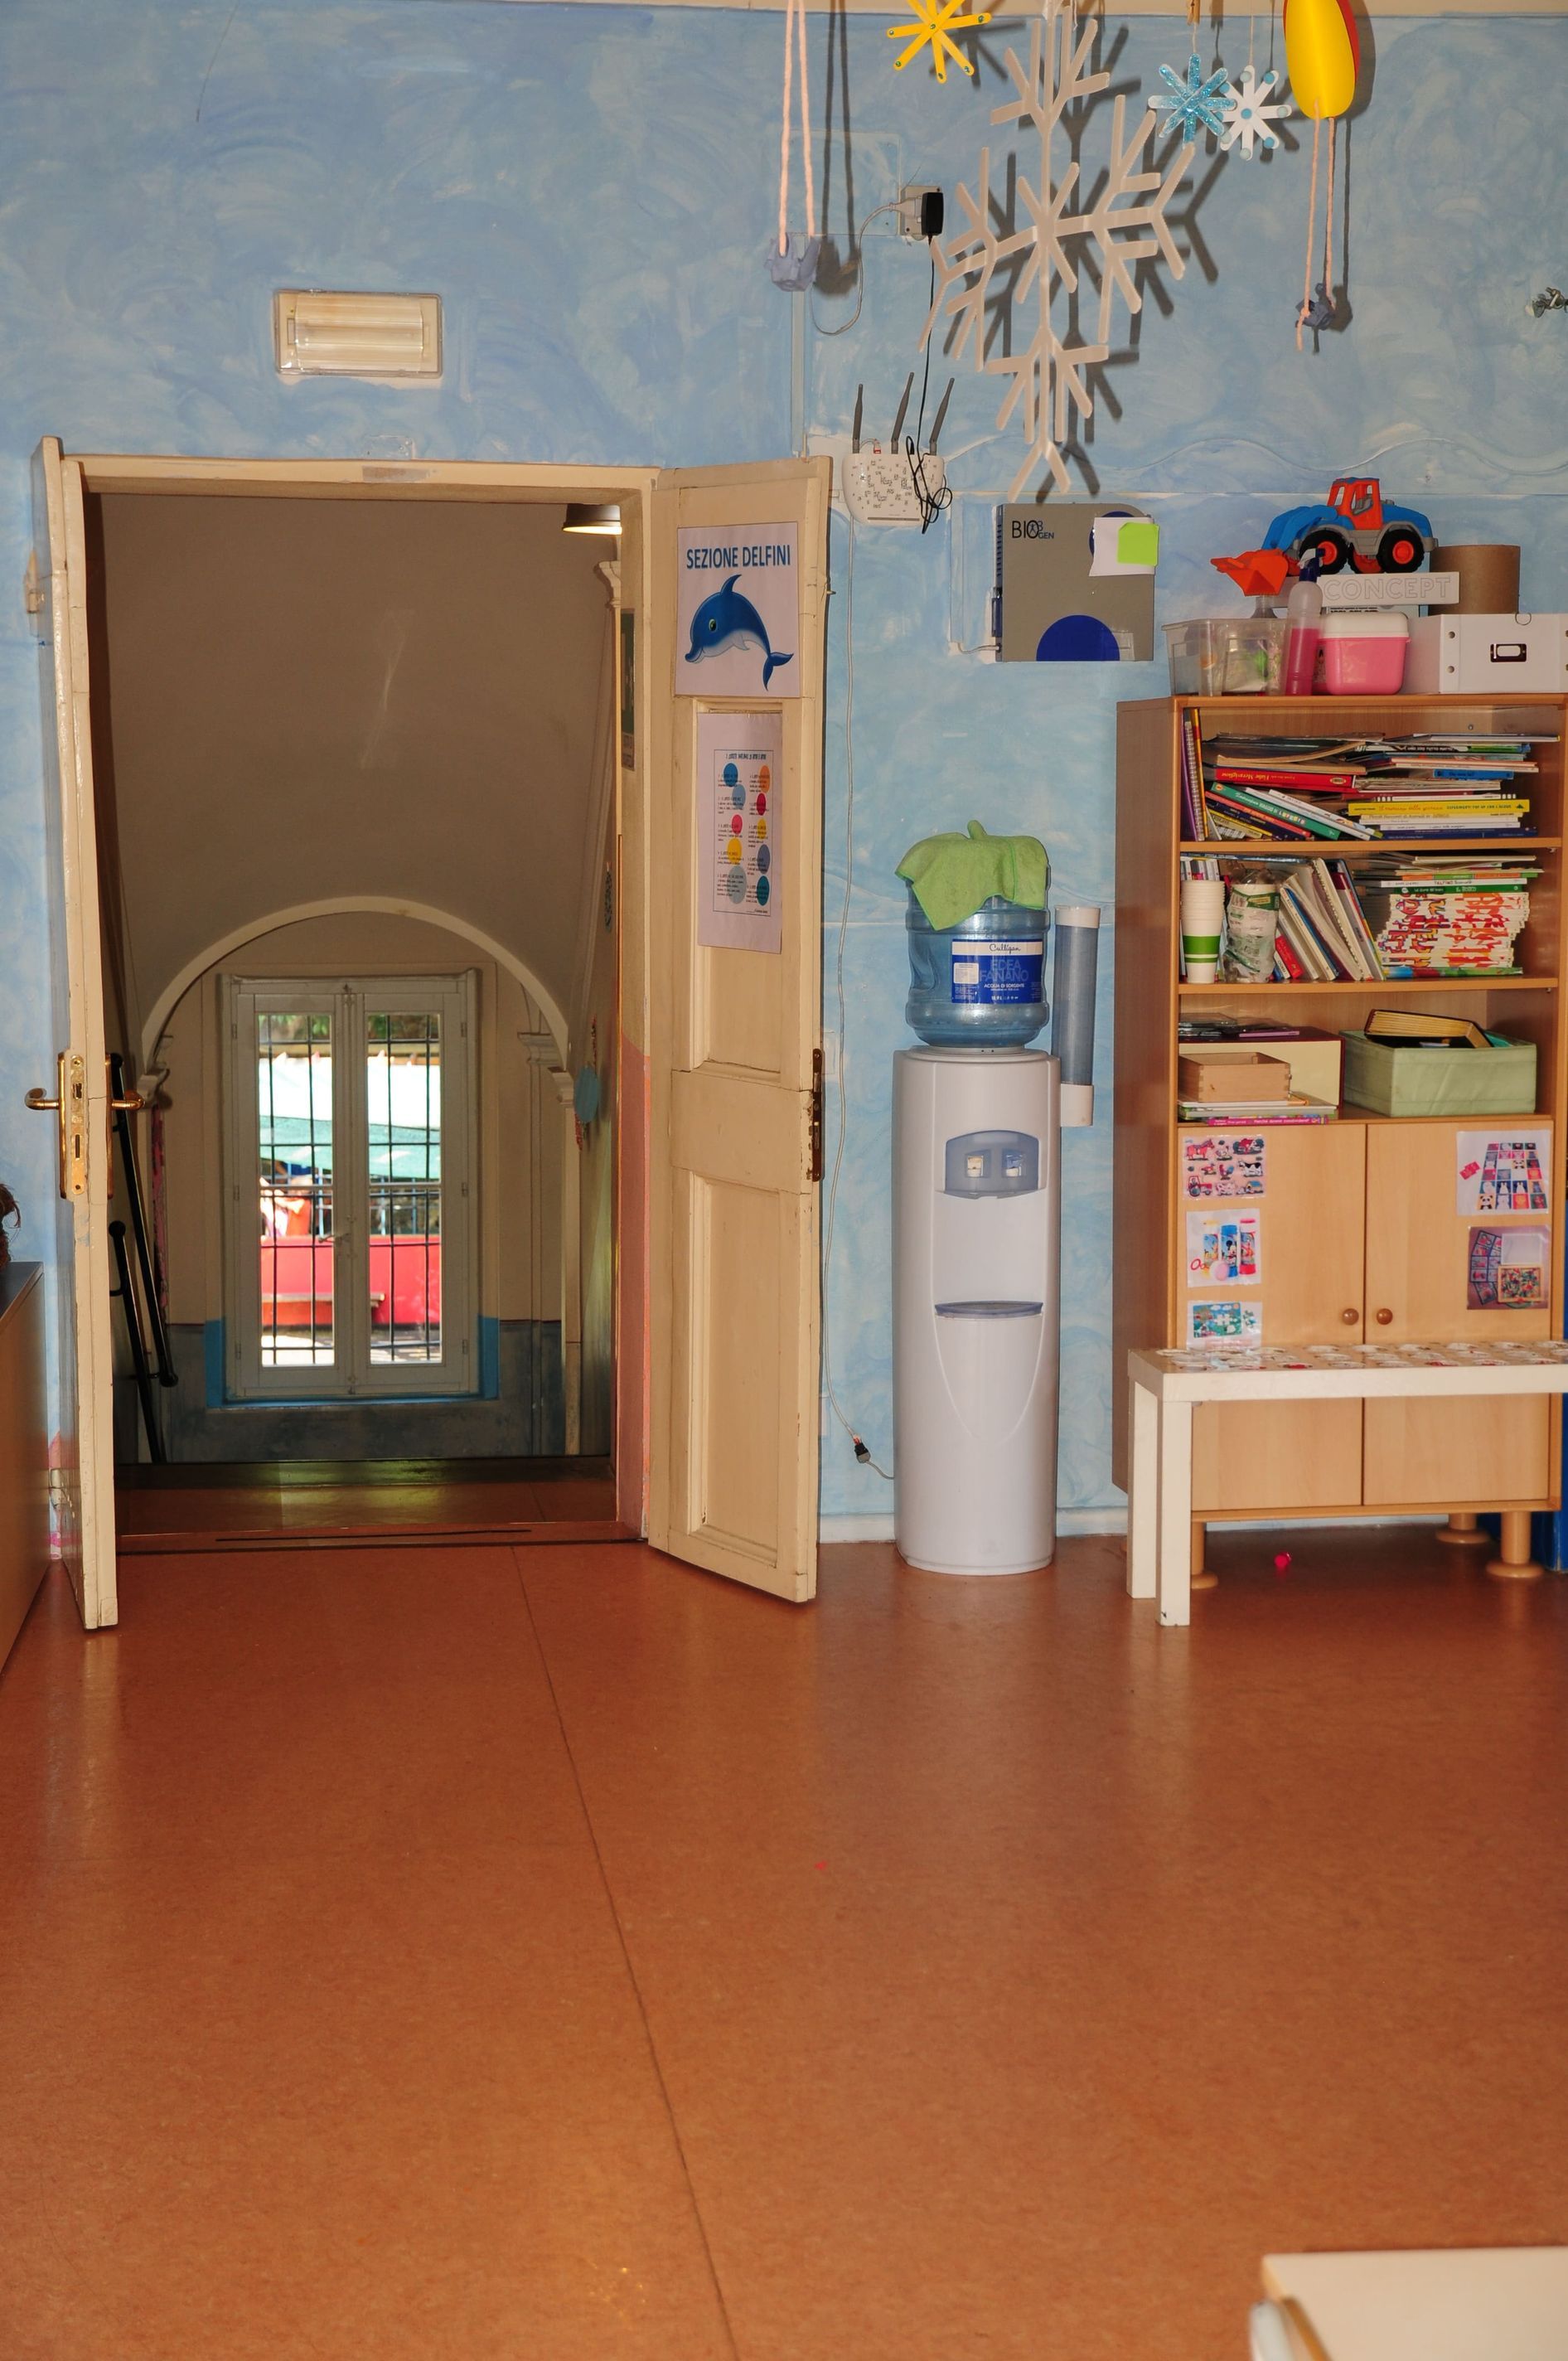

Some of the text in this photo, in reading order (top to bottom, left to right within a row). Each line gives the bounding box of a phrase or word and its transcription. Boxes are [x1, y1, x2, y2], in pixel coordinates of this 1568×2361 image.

[686, 545, 791, 570] SEZIONE DELFINI
[1324, 577, 1450, 601] CONCEPT
[990, 943, 1021, 954] Culligan
[991, 959, 1021, 970] EDEA
[980, 969, 1029, 982] FANANO
